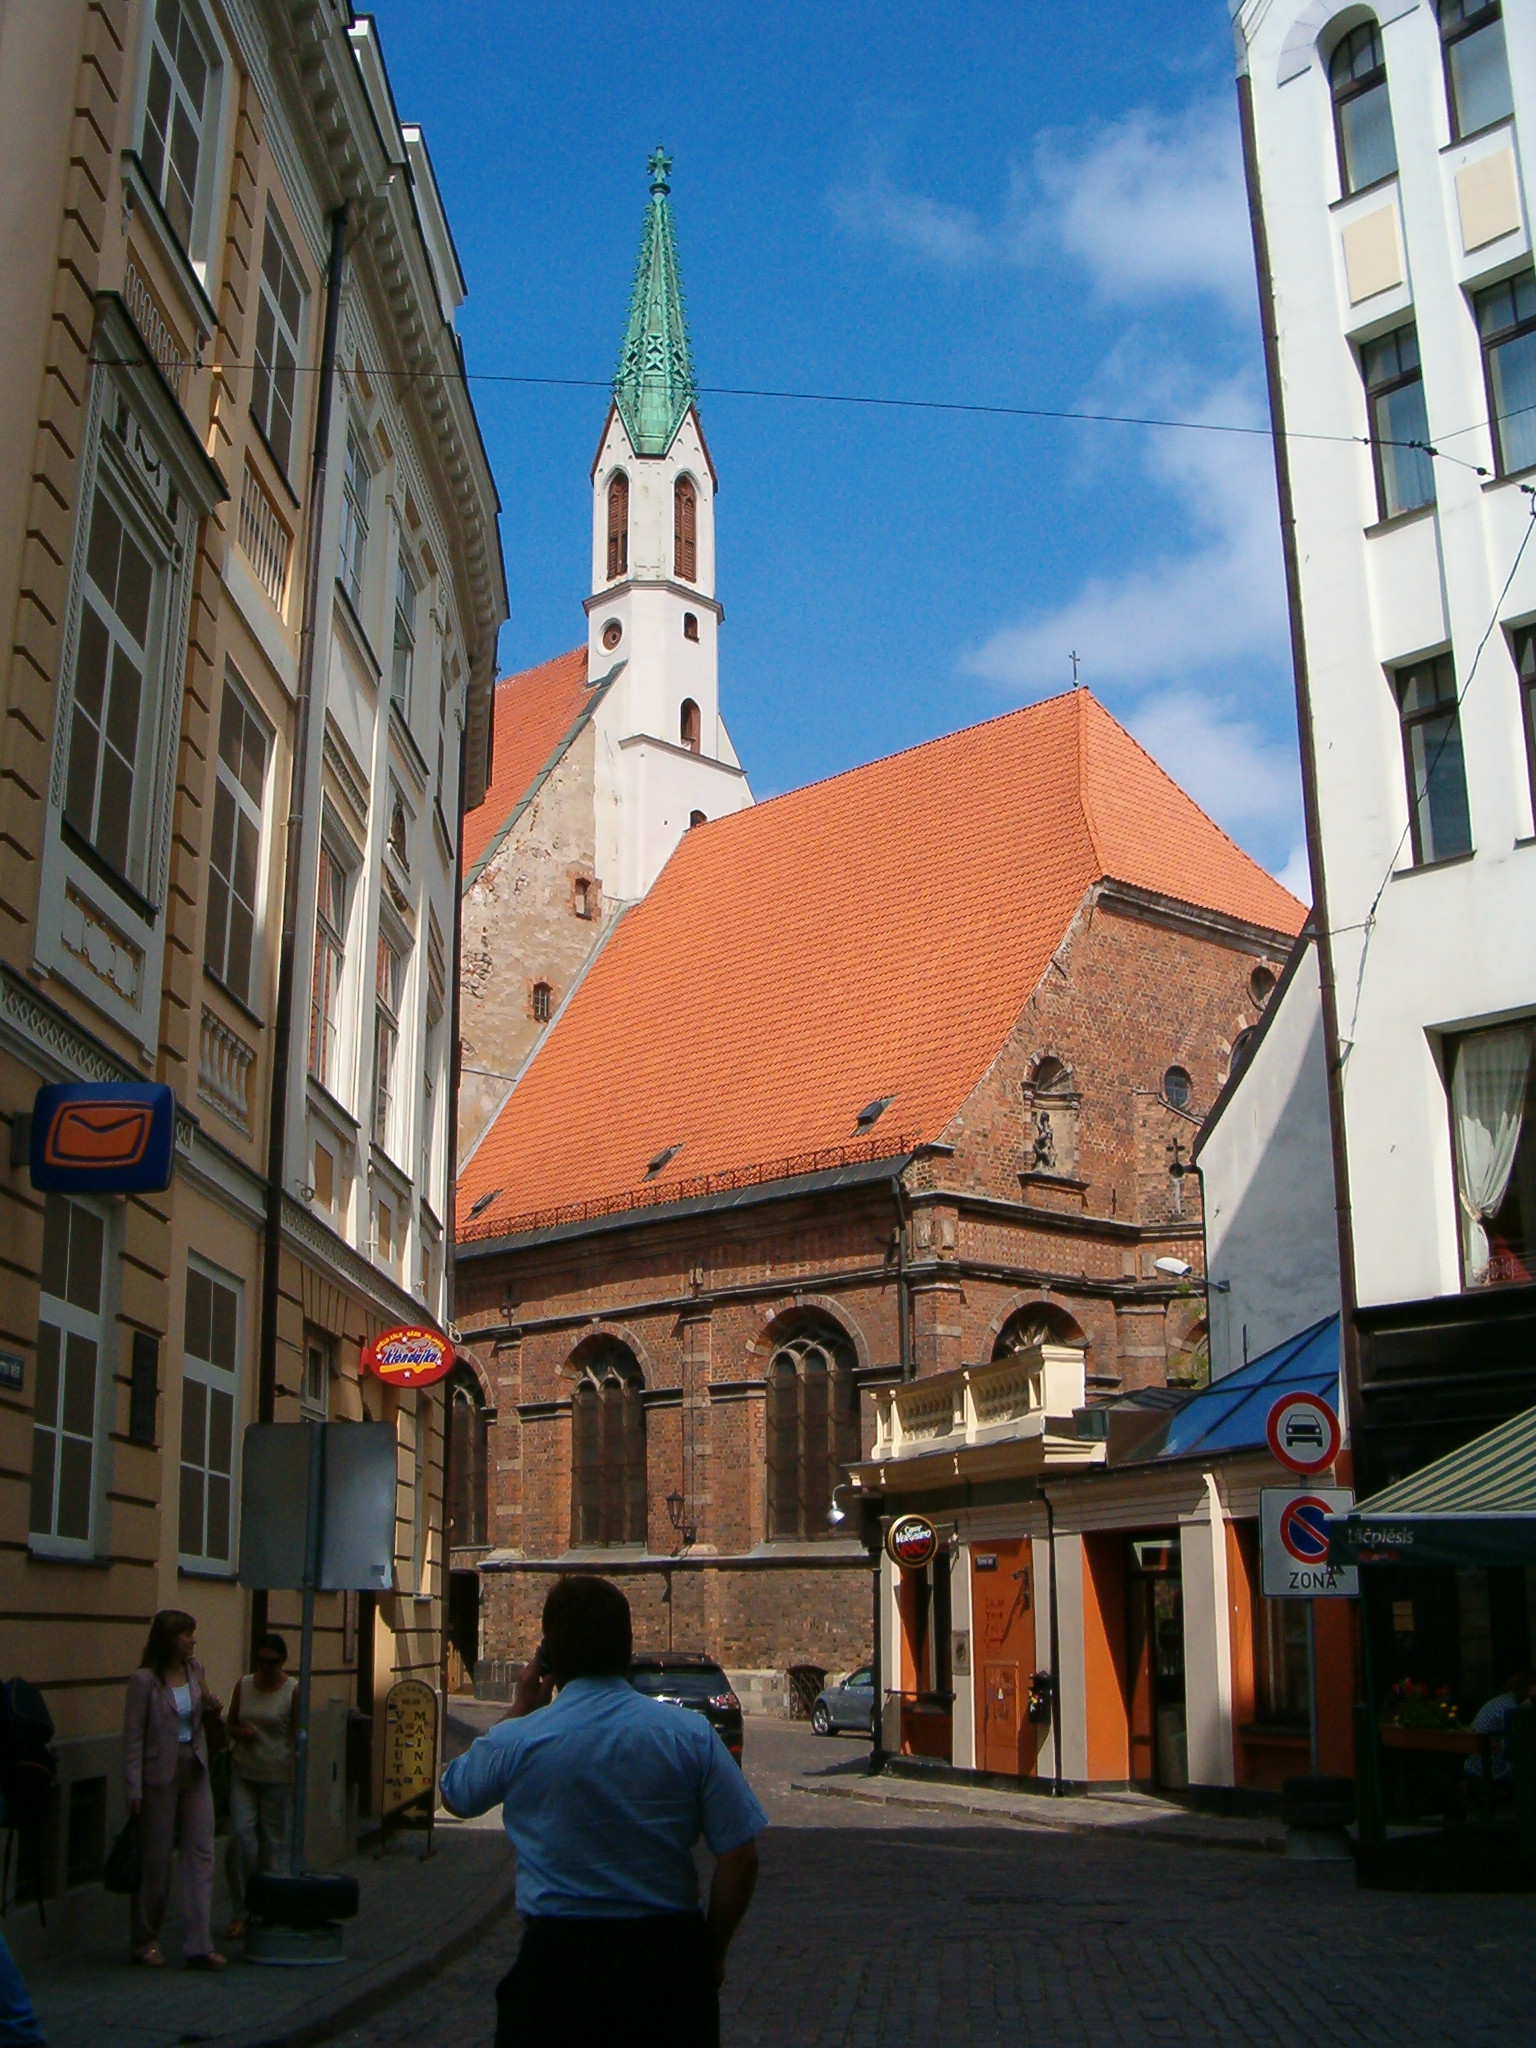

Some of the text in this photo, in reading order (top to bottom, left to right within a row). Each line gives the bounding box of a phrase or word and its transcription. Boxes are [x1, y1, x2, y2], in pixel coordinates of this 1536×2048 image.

[1289, 1572, 1338, 1589] ZONA
[392, 1711, 404, 1800] VALUTAS
[413, 1711, 427, 1775] MAINA
